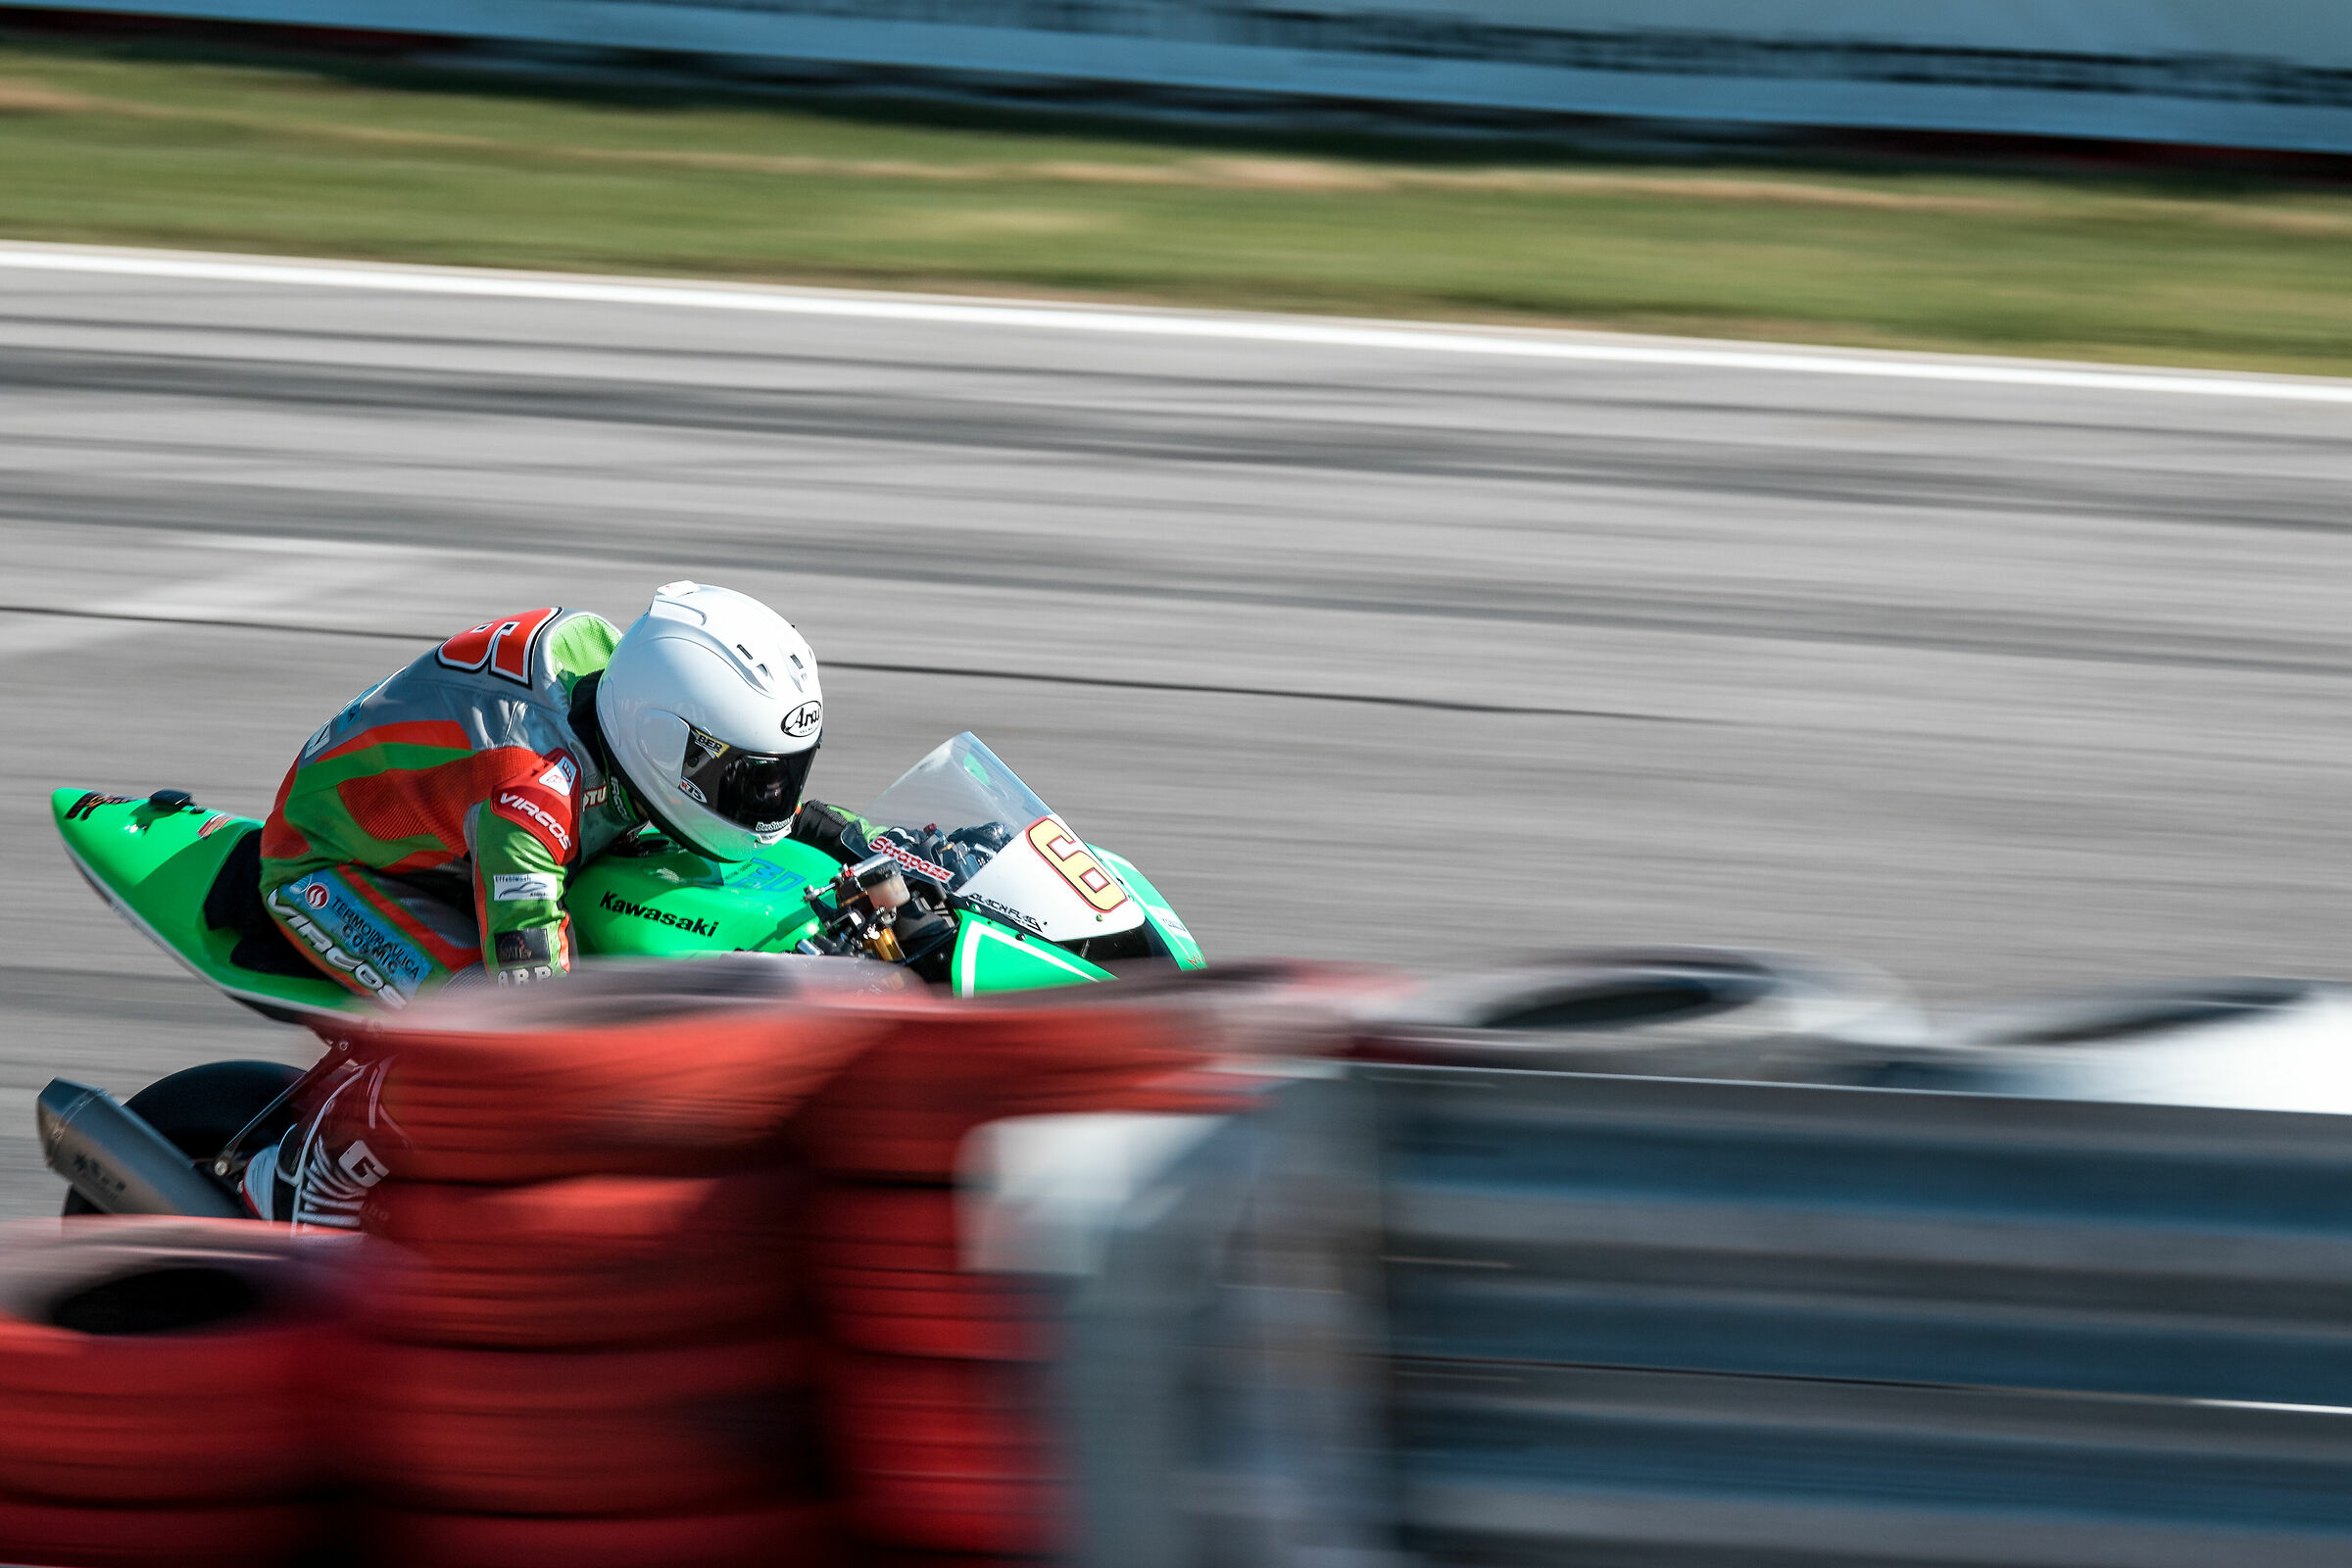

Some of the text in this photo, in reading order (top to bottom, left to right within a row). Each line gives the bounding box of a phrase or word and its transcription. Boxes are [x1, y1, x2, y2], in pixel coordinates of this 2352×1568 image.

[697, 735, 723, 754] BER
[500, 792, 571, 851] VIRCOS
[1025, 815, 1129, 913] 6
[599, 891, 719, 938] Kawasaki
